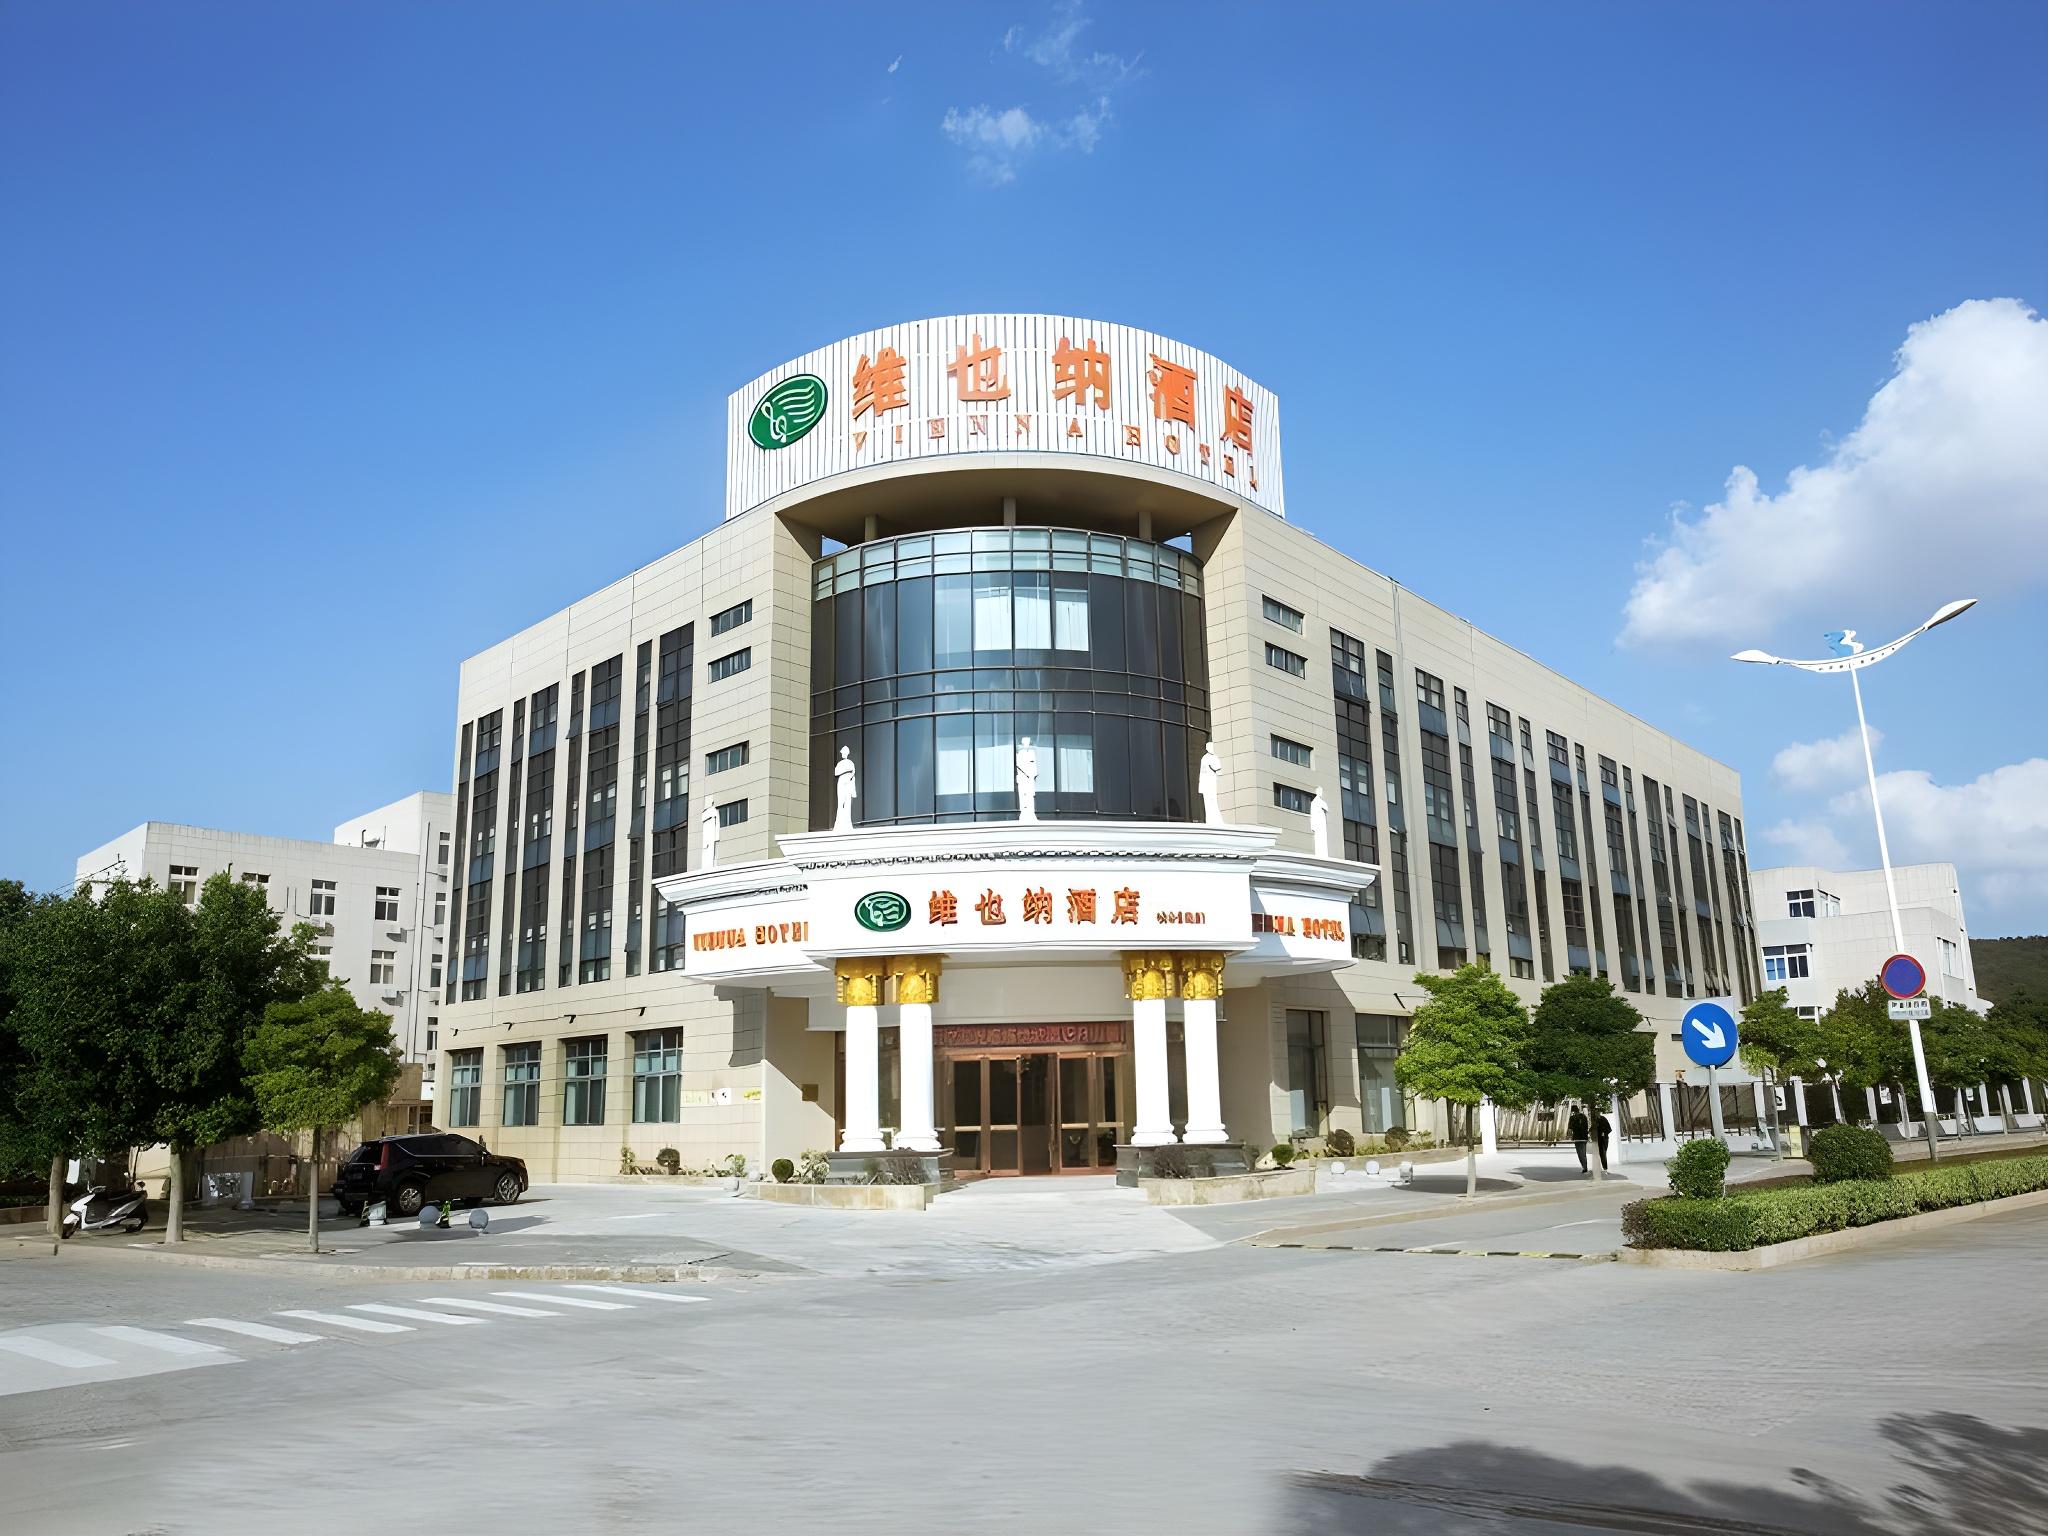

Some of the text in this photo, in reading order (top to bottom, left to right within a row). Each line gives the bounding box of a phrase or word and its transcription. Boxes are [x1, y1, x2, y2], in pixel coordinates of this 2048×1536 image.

[852, 334, 1254, 454] 维也纳酒店
[928, 887, 1139, 926] 维也纳酒店
